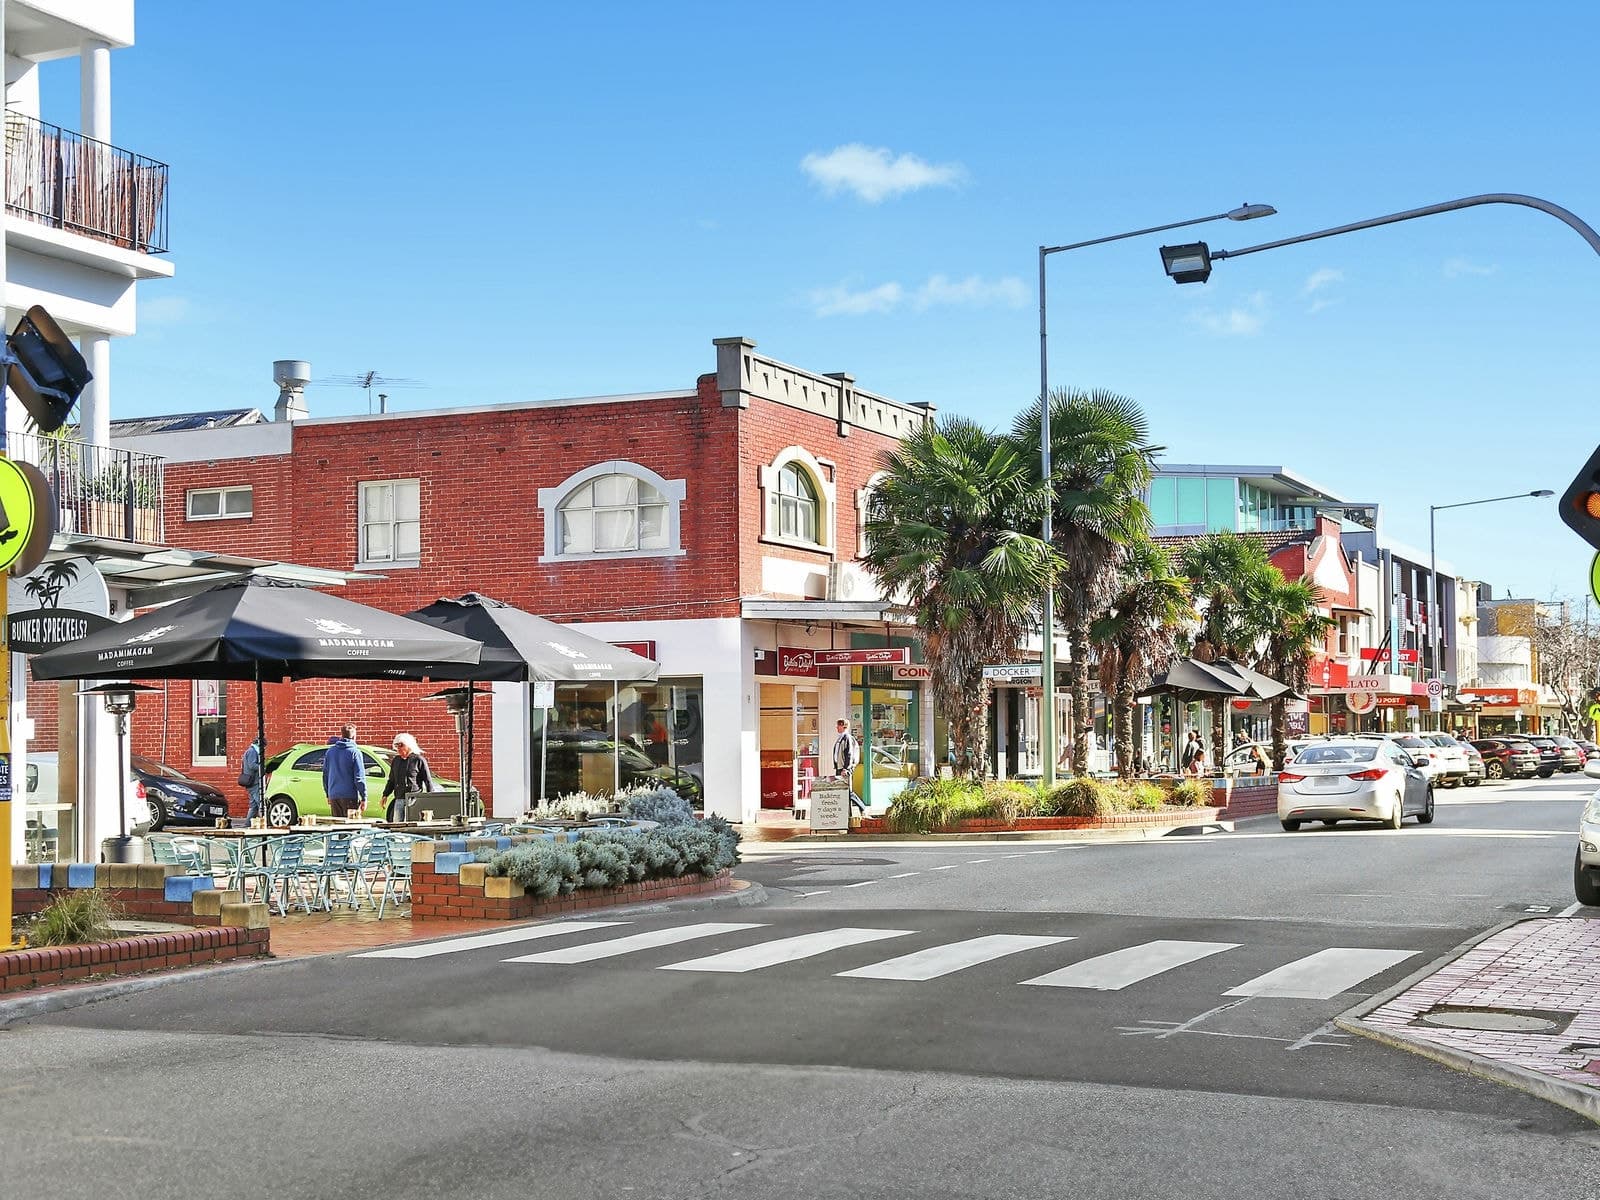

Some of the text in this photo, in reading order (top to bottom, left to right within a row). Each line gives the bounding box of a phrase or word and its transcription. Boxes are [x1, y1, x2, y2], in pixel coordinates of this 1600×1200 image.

[11, 617, 88, 643] BUNKER SPRECKELS?
[116, 660, 134, 668] COFFEE
[992, 667, 1030, 676] DOCKER
[0, 765, 9, 775] TE
